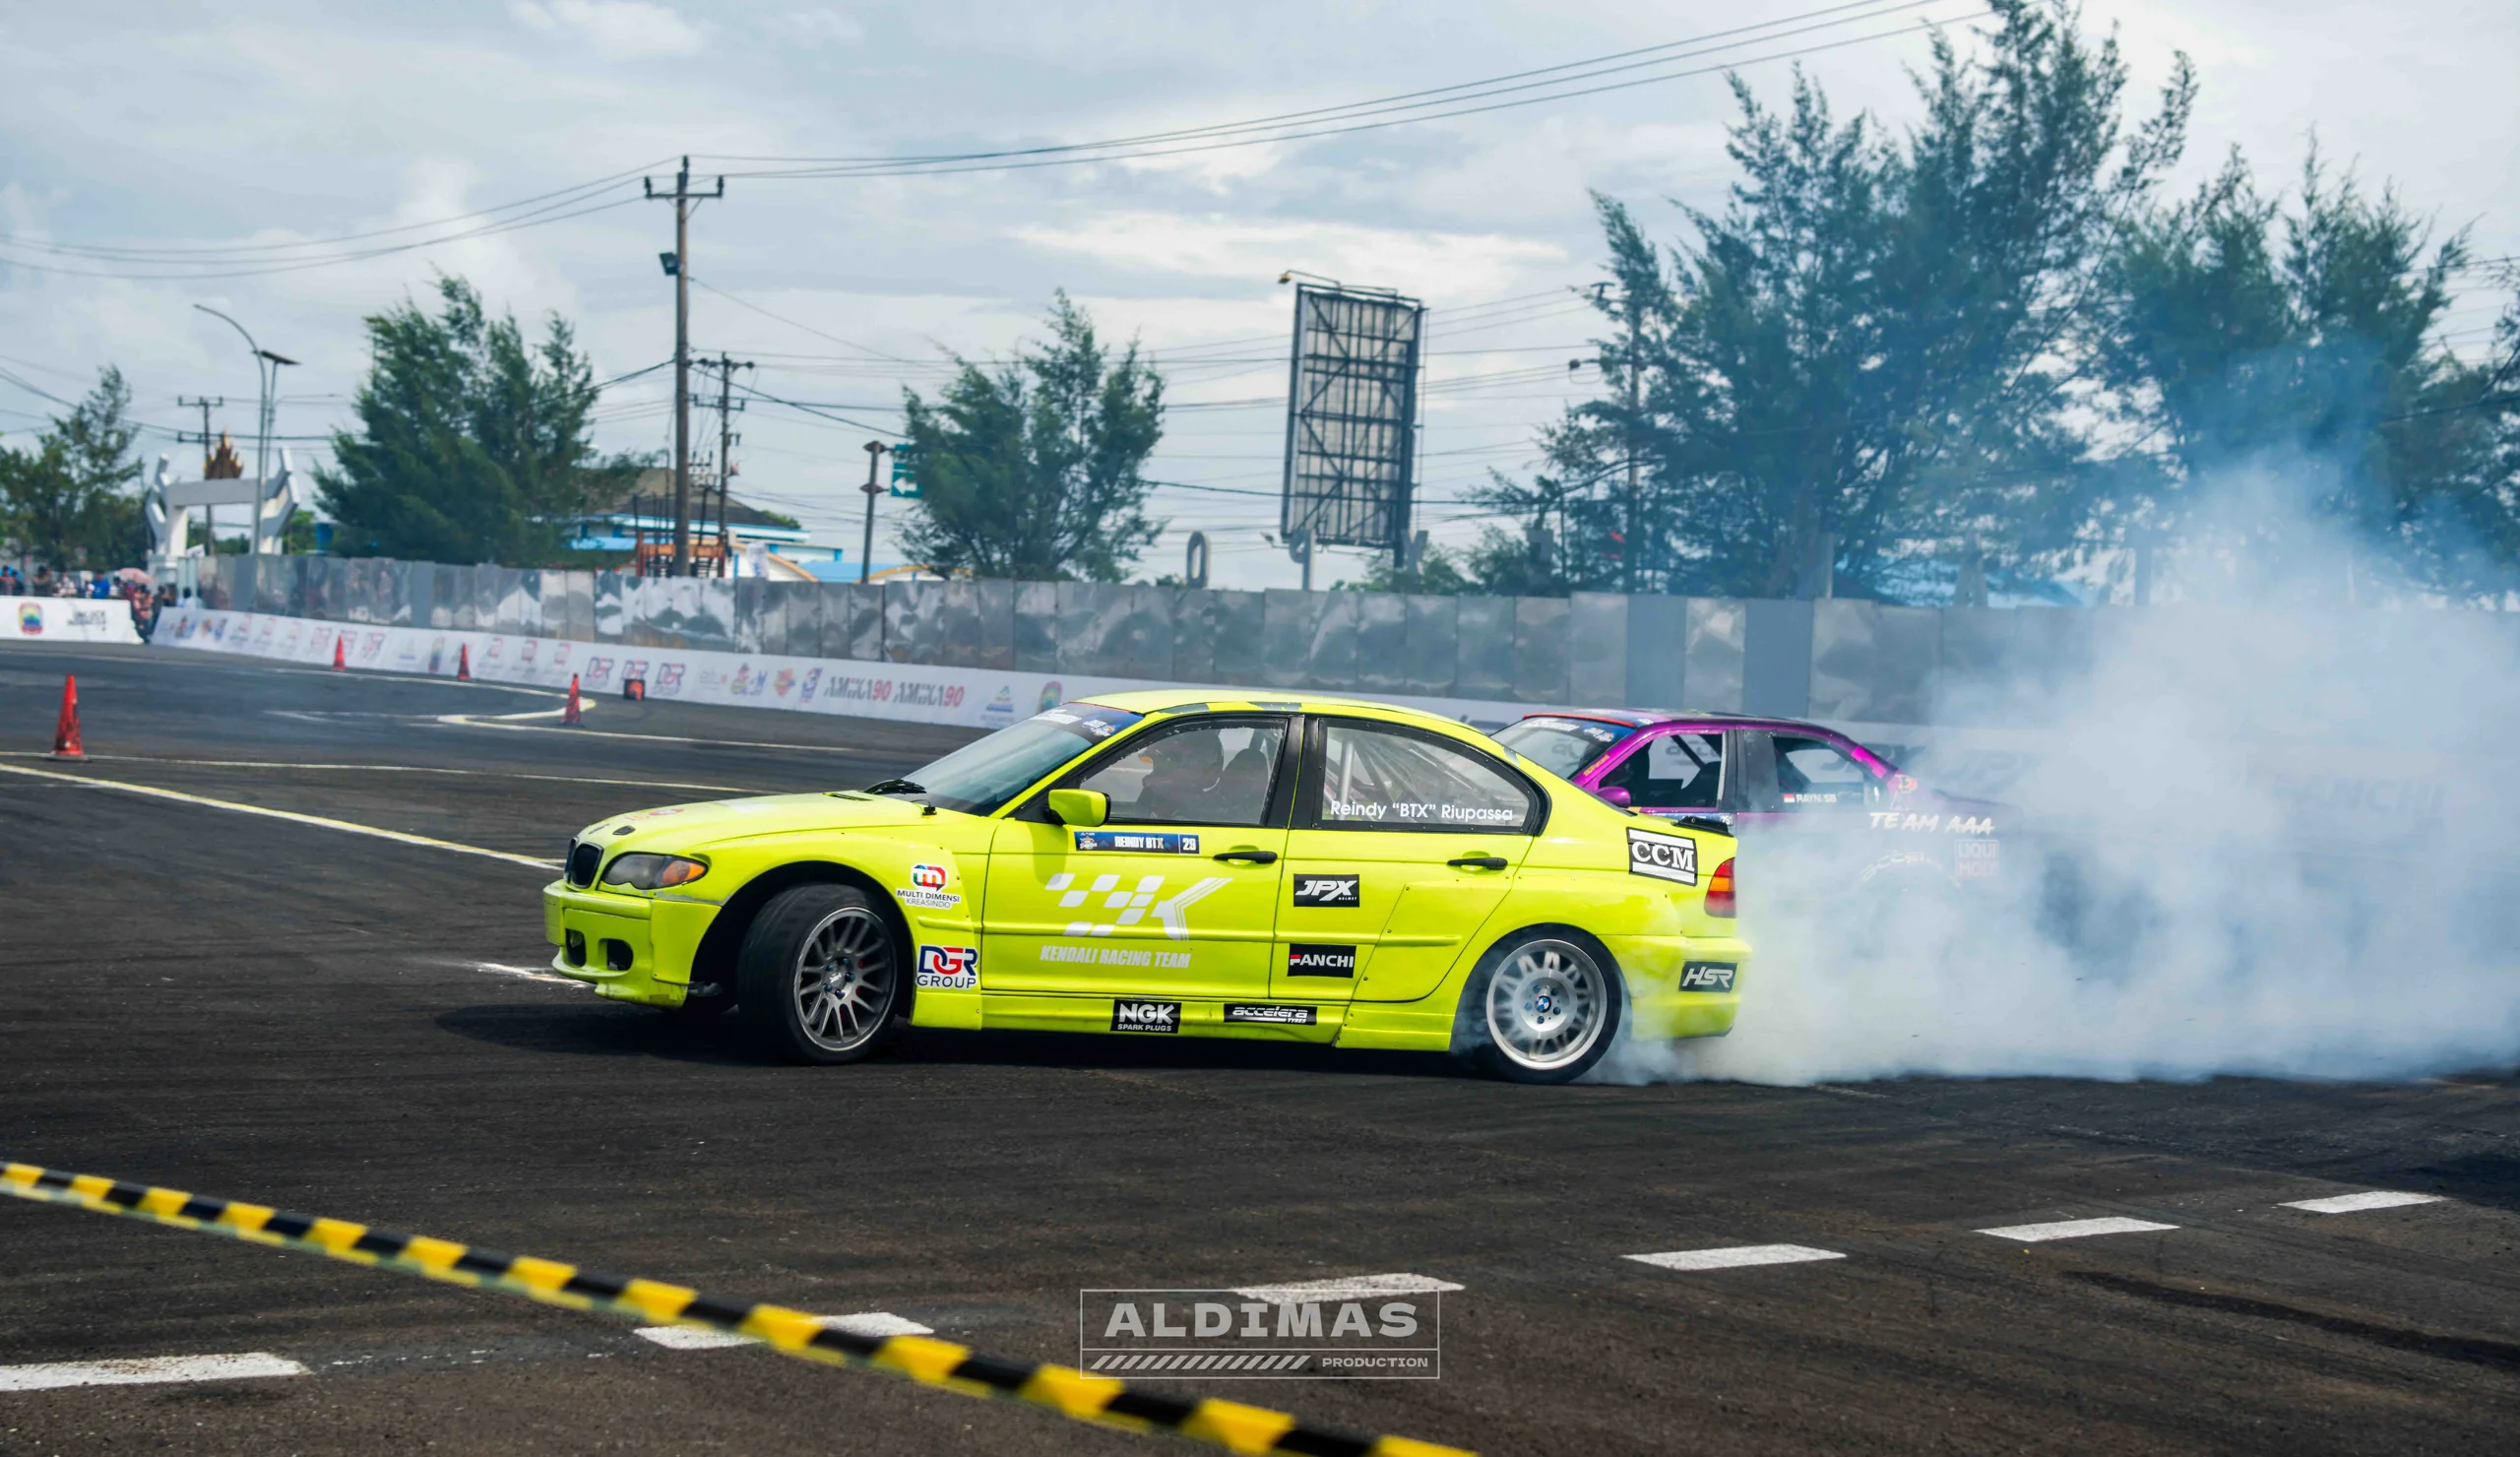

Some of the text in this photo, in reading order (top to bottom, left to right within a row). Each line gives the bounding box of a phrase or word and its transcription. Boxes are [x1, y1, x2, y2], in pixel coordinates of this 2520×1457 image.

[1330, 800, 1387, 819] Reindy
[1441, 804, 1513, 822] Riupassa
[1869, 811, 1940, 833] TEAM
[1114, 836, 1165, 849] REINDY BTX
[1957, 843, 1996, 858] LIQUI
[1631, 841, 1695, 872] CCM
[897, 890, 960, 903] MULTI DIMENSI
[1294, 880, 1357, 901] JPX
[906, 898, 951, 909] KREASINDO
[917, 945, 978, 977] DGR
[1040, 945, 1191, 969] KENDALI RACING TEAM
[1290, 954, 1354, 968] FANCHI
[916, 975, 976, 988] GROUP
[1681, 966, 1733, 988] HSR
[1118, 1003, 1174, 1025] NGK
[1231, 1006, 1308, 1018] accelera
